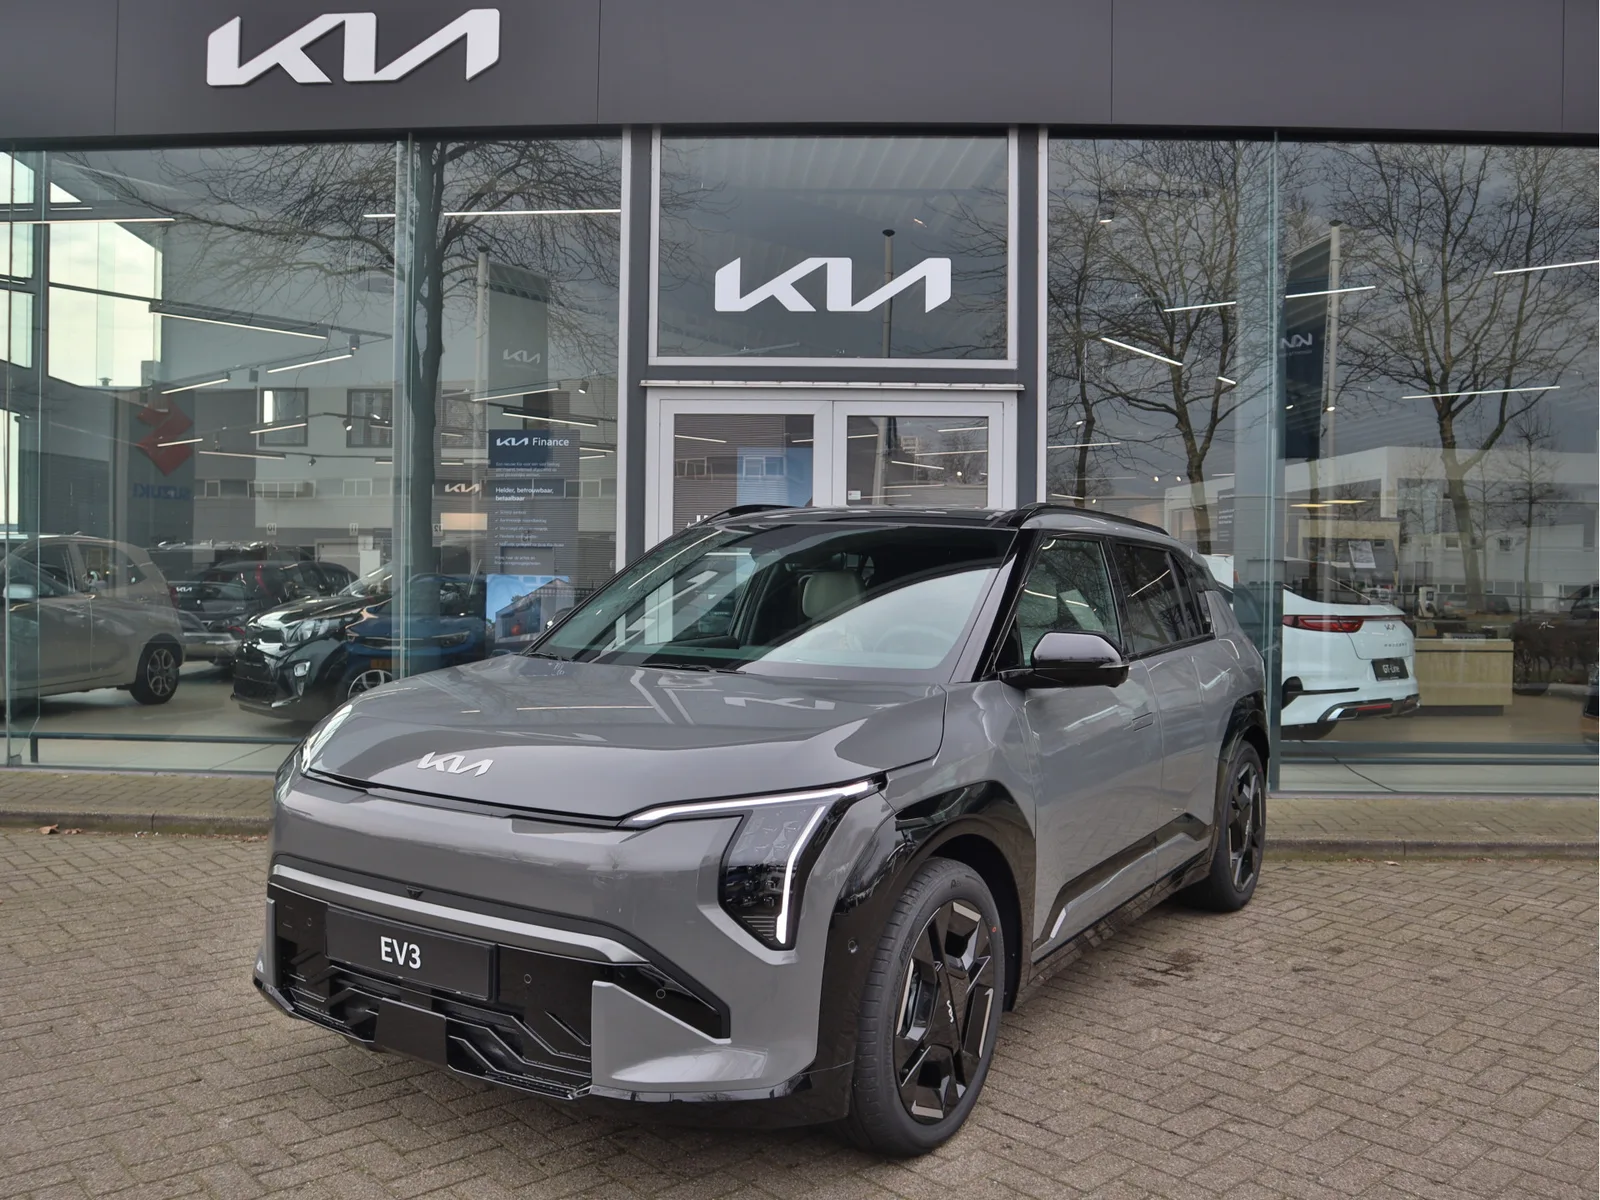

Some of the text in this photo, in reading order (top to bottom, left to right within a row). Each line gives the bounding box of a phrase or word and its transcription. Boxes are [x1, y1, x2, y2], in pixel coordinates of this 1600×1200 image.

[206, 8, 500, 86] KIA
[715, 257, 951, 313] KIA
[503, 349, 541, 364] KIA
[496, 437, 570, 446] KIA Finance
[444, 483, 480, 493] KIA
[516, 487, 554, 495] betrouwbaar,
[417, 751, 494, 777] KIA
[379, 935, 422, 970] EV3
